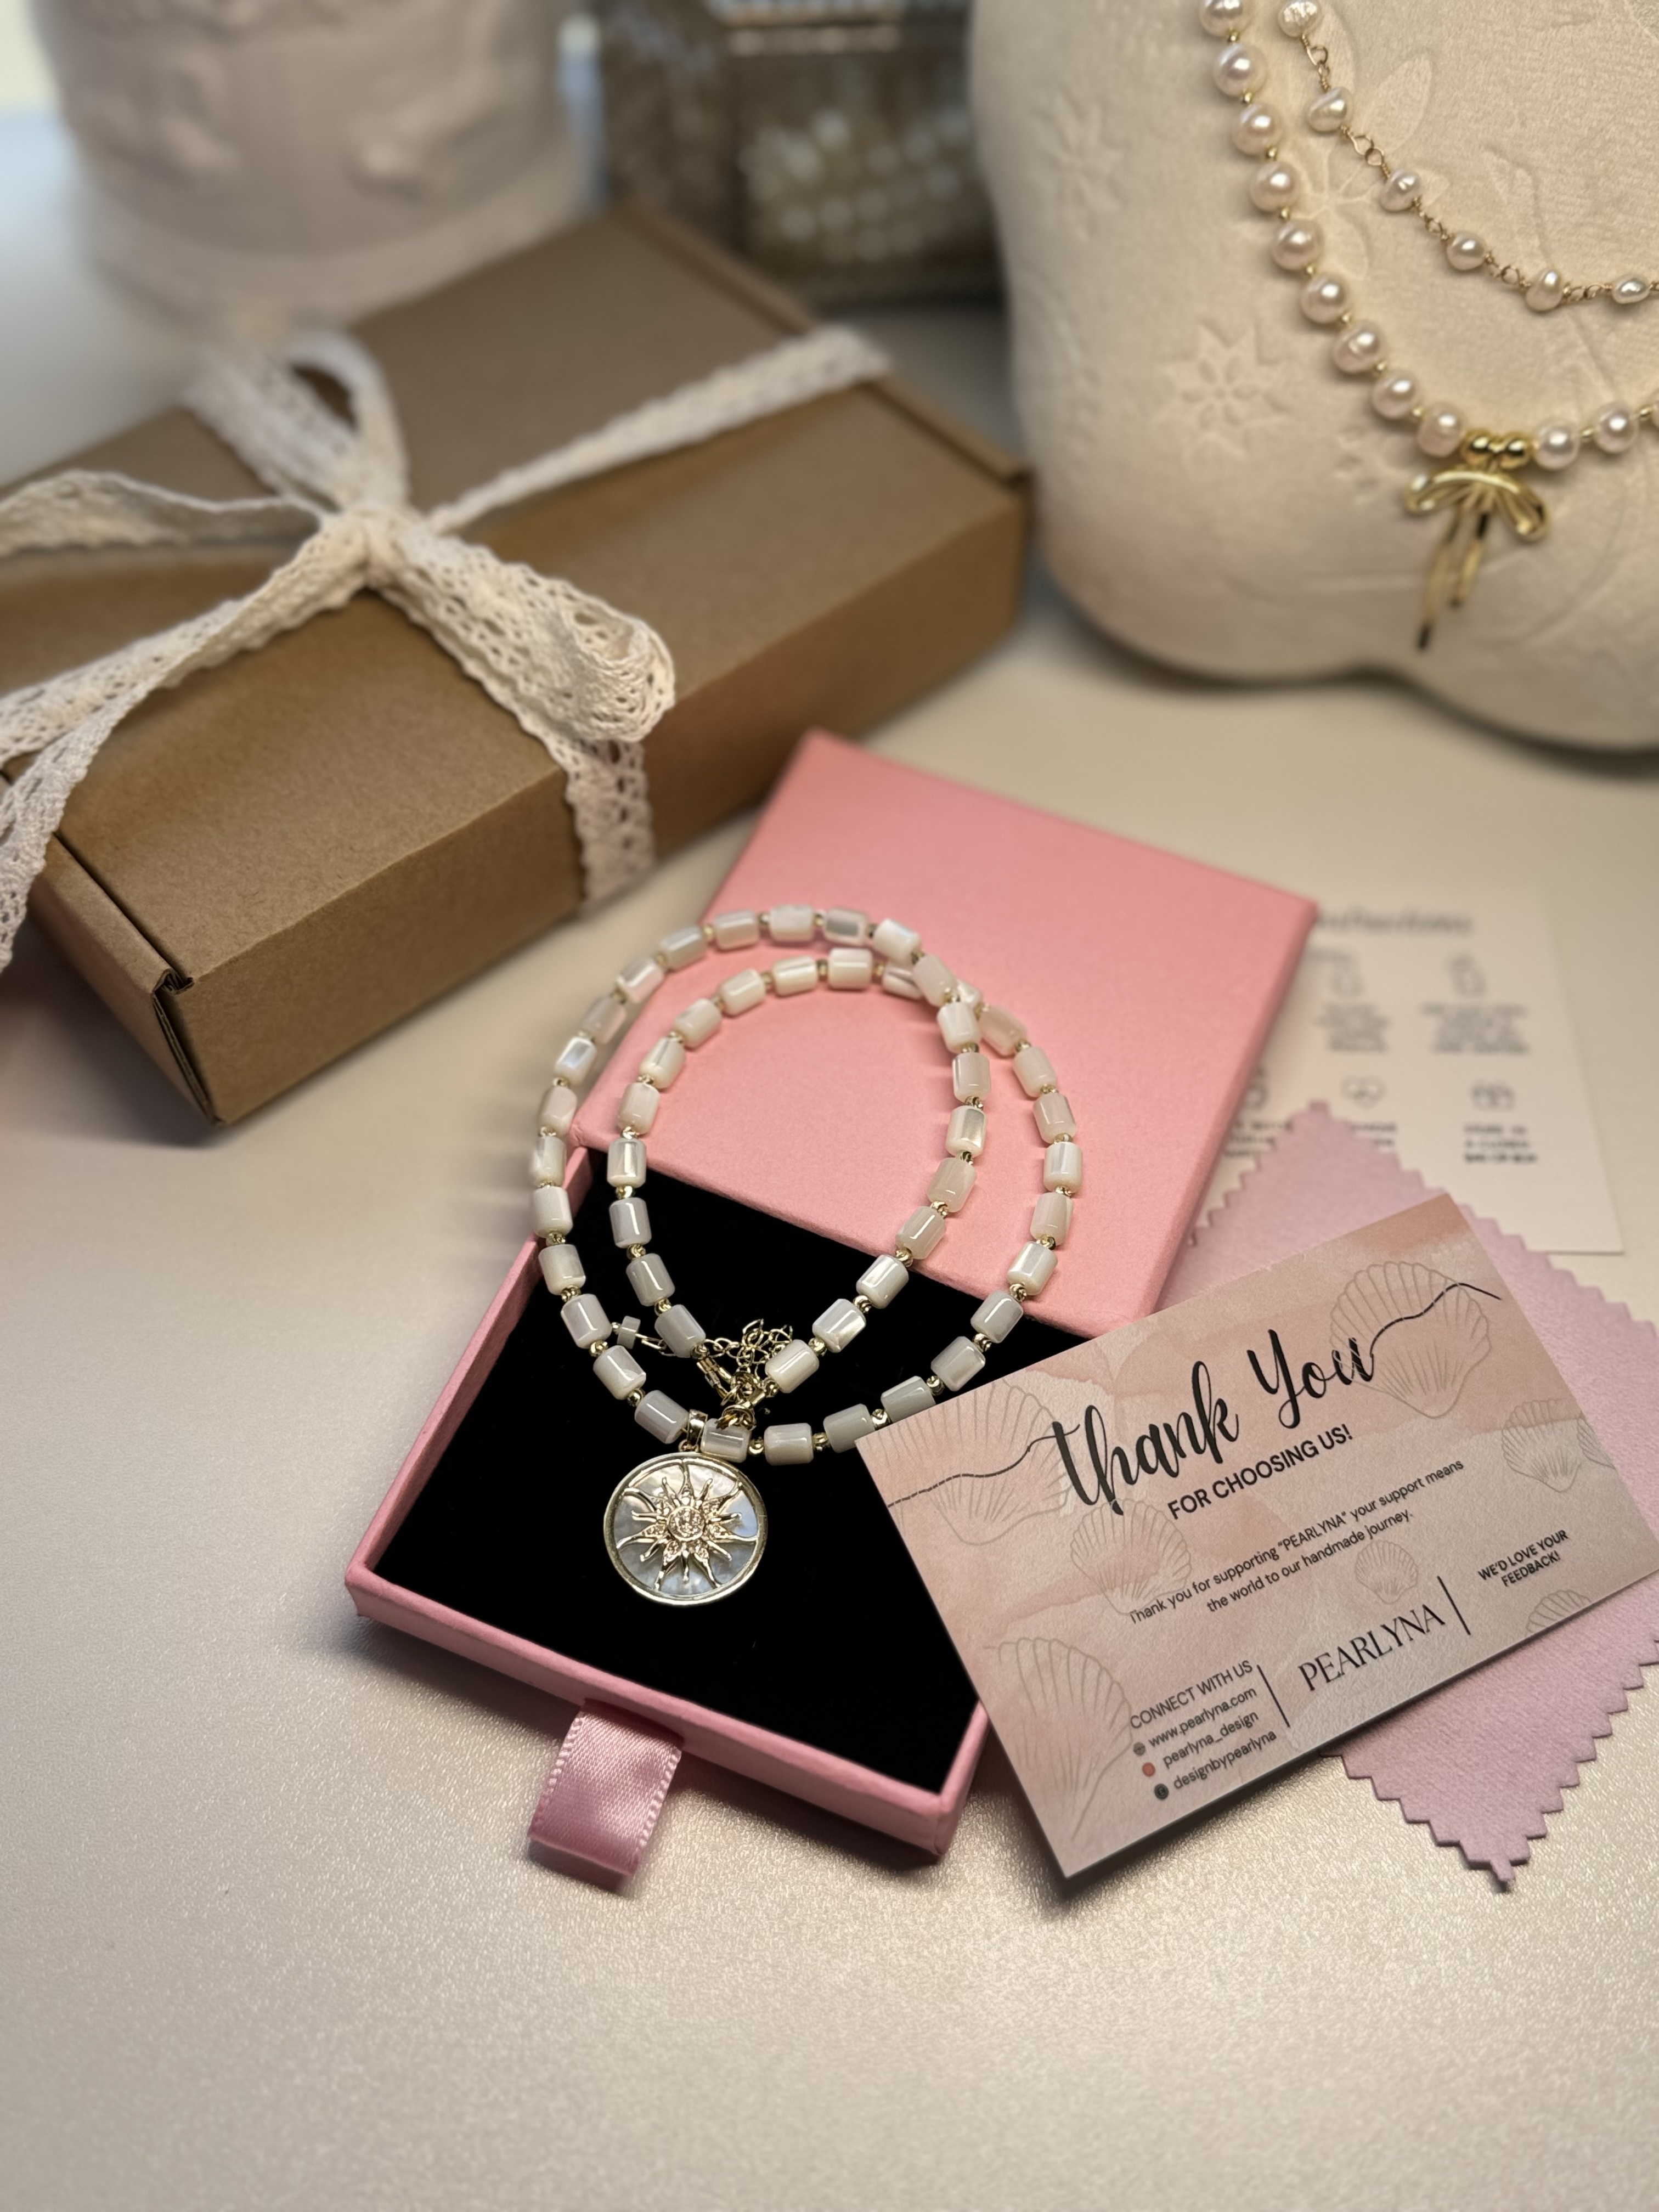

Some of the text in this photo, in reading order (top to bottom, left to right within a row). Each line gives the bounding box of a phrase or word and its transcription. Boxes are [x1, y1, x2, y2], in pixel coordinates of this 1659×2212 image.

[1246, 1329, 1374, 1429] You
[1167, 1423, 1353, 1520] FOR CHOOSING US!
[1128, 1598, 1168, 1624] Thank
[1167, 1588, 1193, 1610] you
[1192, 1578, 1211, 1594] for
[1212, 1547, 1280, 1585] supporting
[1350, 1500, 1378, 1522] your
[1378, 1477, 1425, 1506] support
[1425, 1459, 1465, 1485] means
[1206, 1509, 1414, 1612] the world to our handmade journey.
[1477, 1529, 1569, 1581] WE'D LOVE YOUR
[1500, 1550, 1561, 1587] FEEDBACK!
[1297, 1604, 1446, 1691] PEARLYNA
[1130, 1660, 1254, 1729] CONNECT WITH US
[1148, 1688, 1257, 1747] www.pearlyna.com
[1162, 1711, 1260, 1770] pearlyna_design
[1173, 1730, 1278, 1790] designbypearlyna
